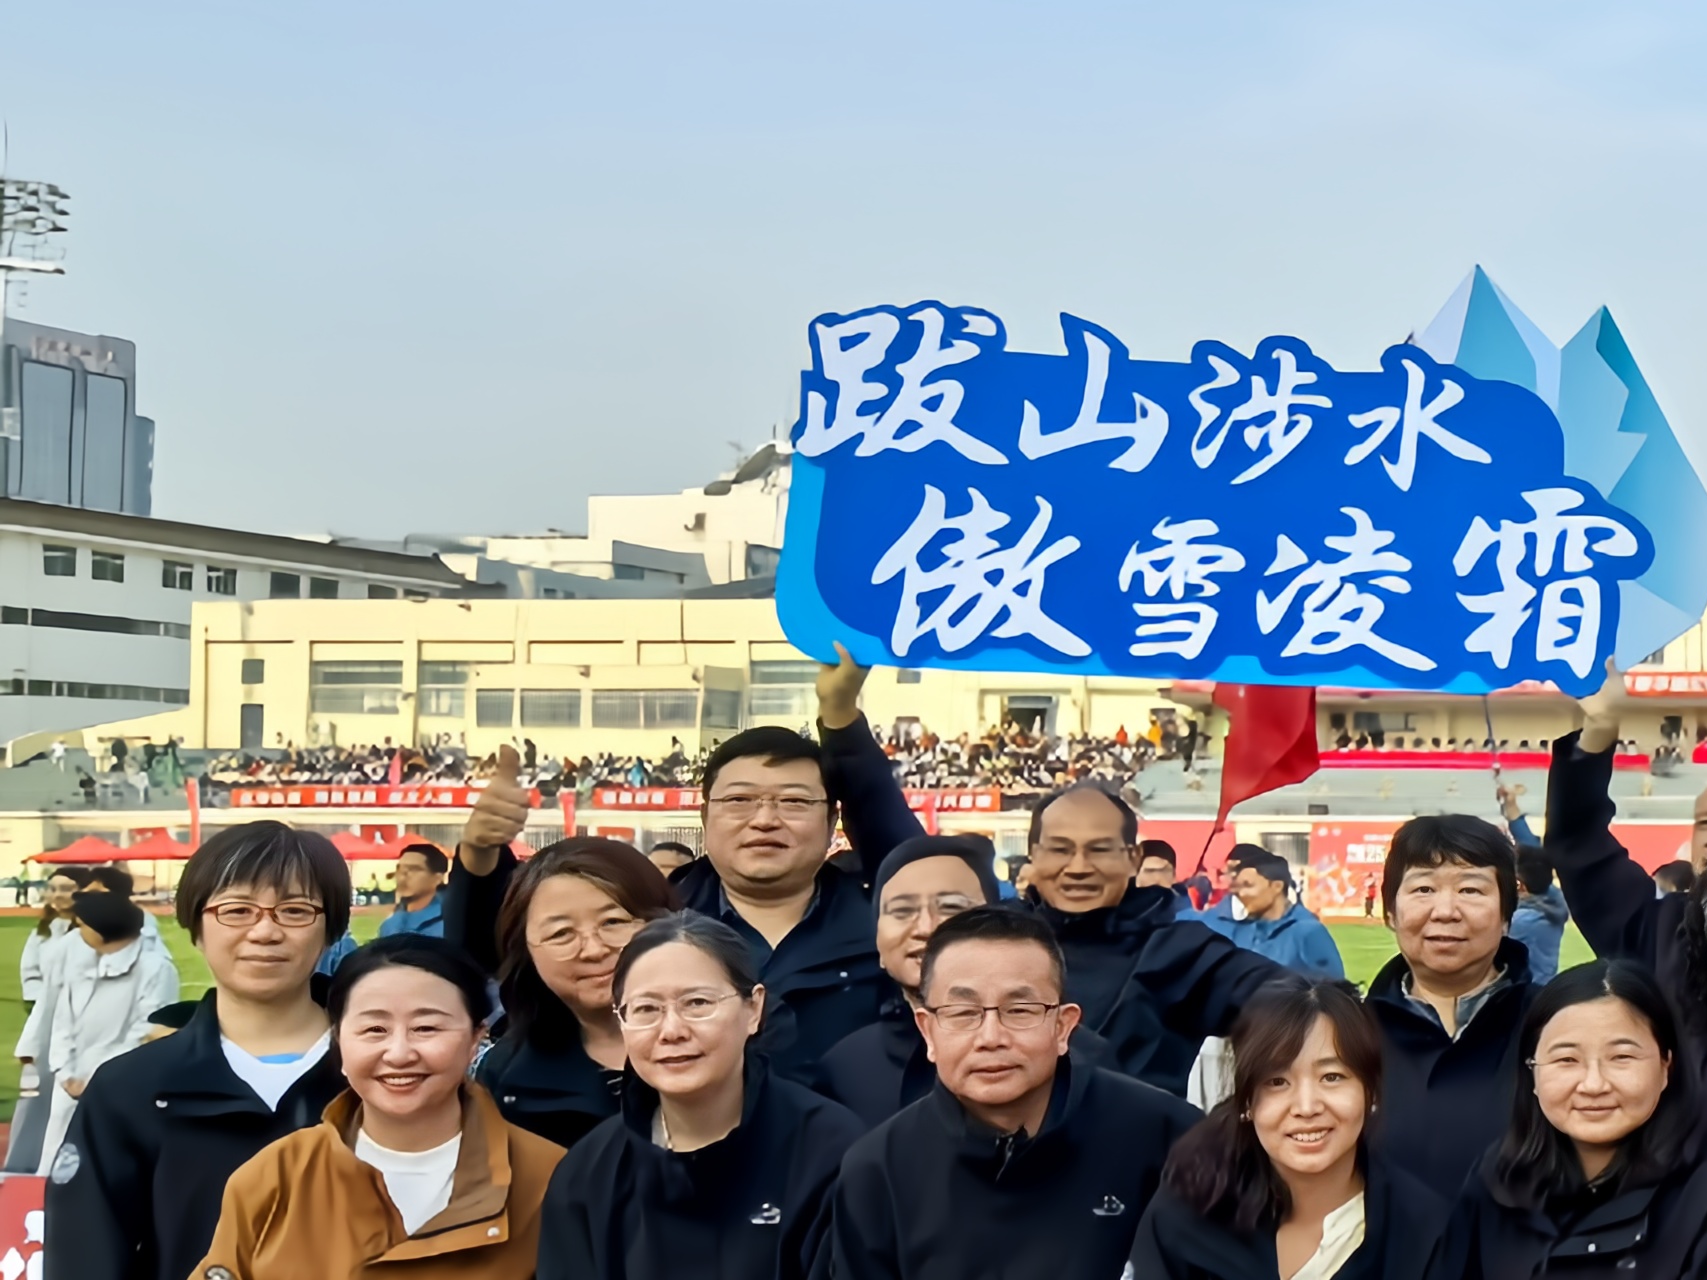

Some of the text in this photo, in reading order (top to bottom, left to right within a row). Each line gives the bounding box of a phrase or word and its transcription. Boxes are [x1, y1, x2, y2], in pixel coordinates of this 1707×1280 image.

[795, 306, 1493, 492] 跋山涉水
[871, 484, 1640, 680] 傲雪凌霜
